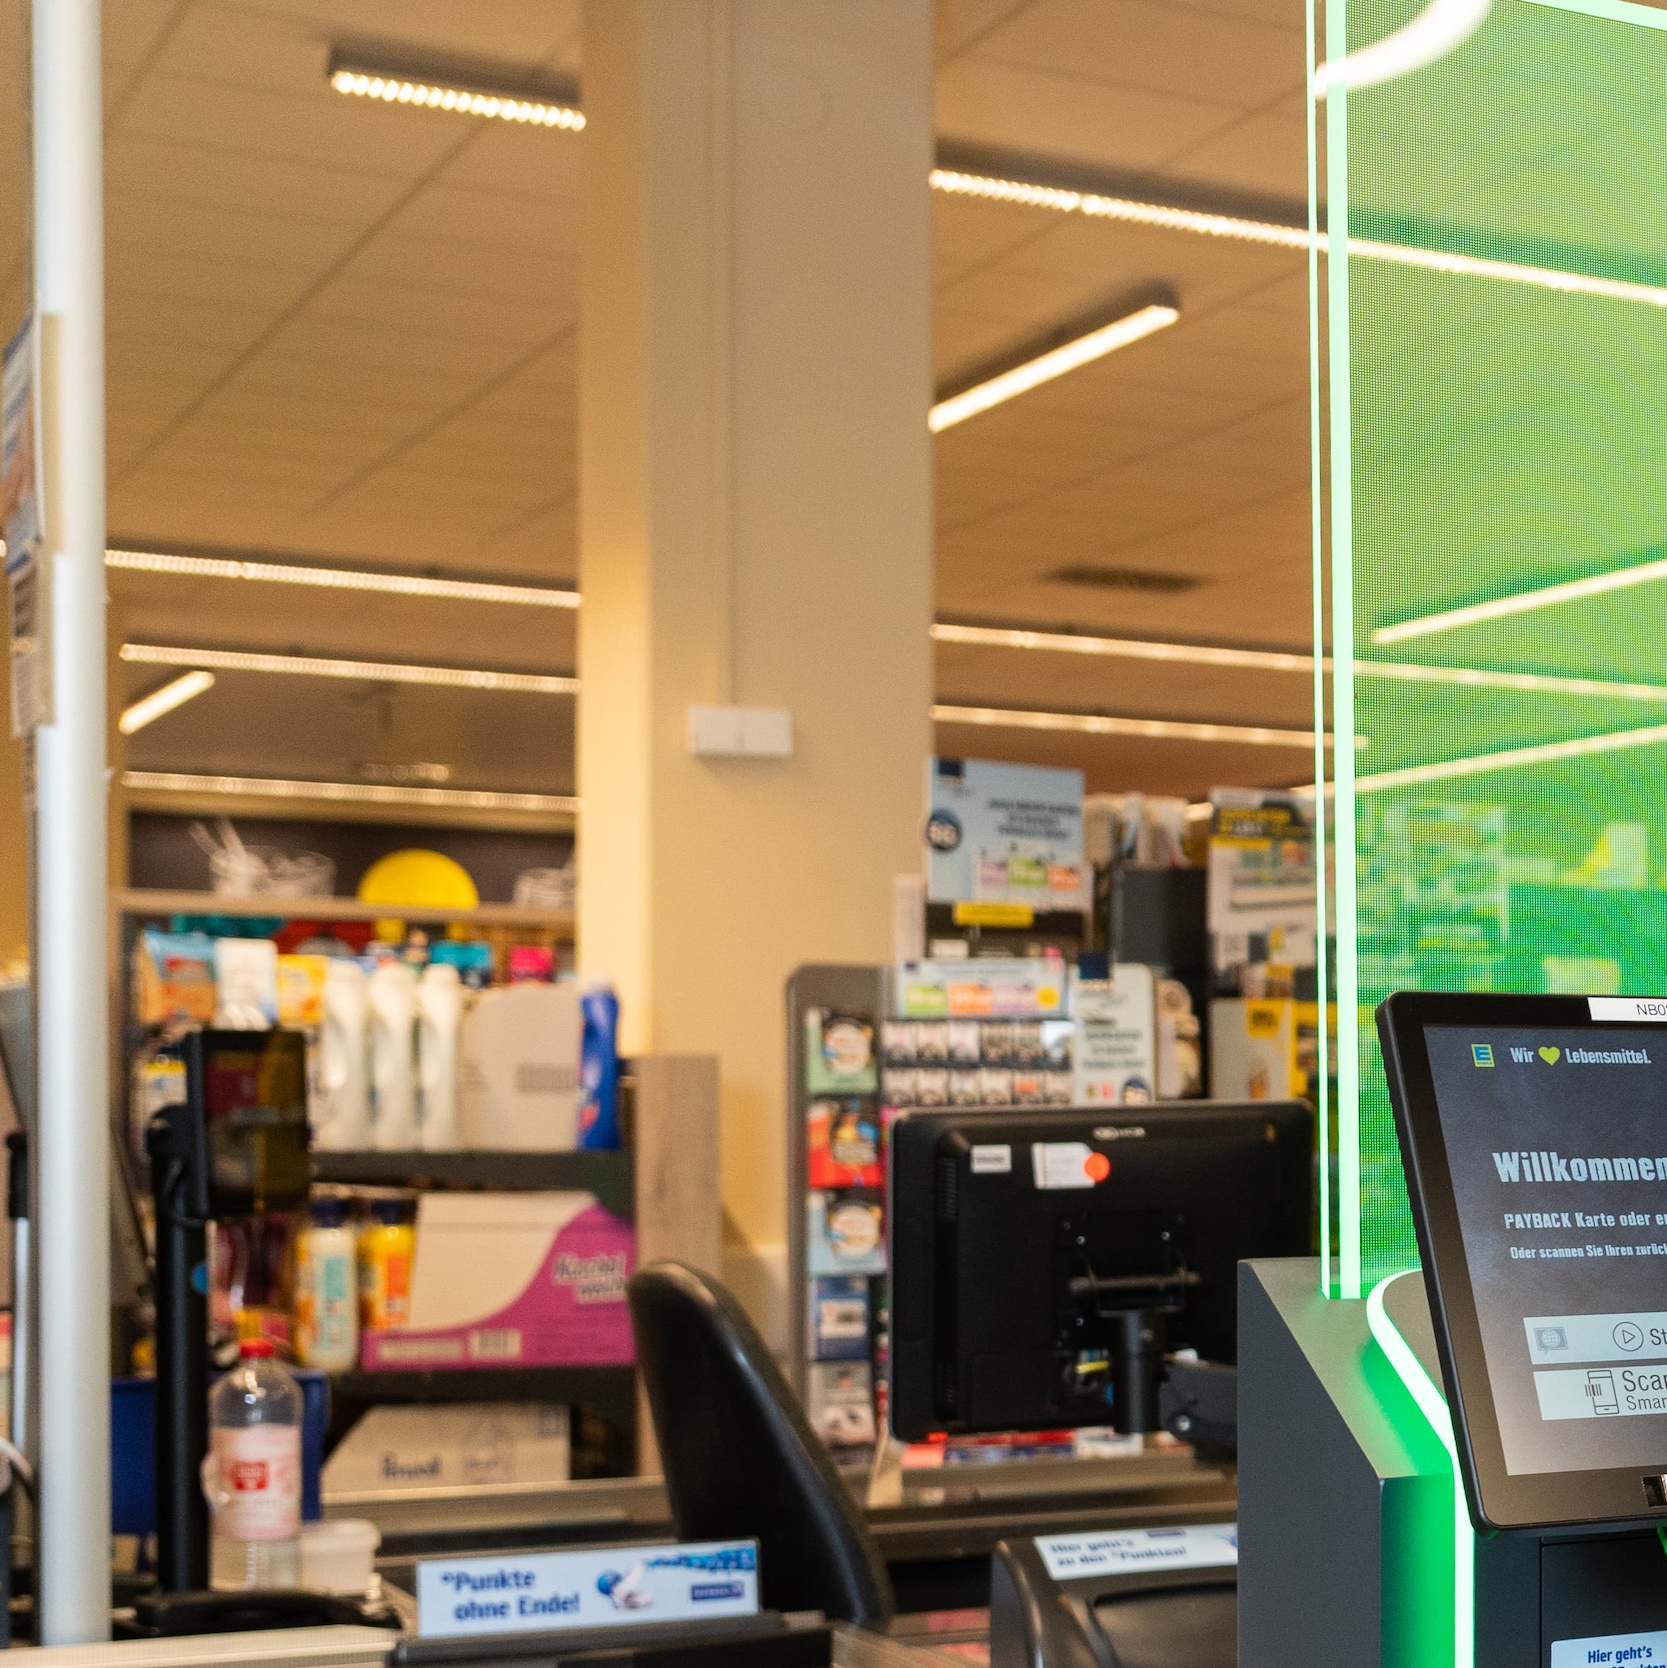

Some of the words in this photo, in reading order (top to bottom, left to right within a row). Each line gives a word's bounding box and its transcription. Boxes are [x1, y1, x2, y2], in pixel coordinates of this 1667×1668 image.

[1510, 1047, 1535, 1063] Wir
[1565, 1048, 1652, 1065] Lebensmittel.
[1504, 1212, 1572, 1229] PAYBACK
[1575, 1211, 1616, 1227] Karte
[1619, 1210, 1651, 1226] oder
[1510, 1246, 1536, 1260] Oder
[1539, 1246, 1584, 1258] scannen
[1586, 1244, 1603, 1258] Sie
[1605, 1244, 1633, 1257] Ihren
[453, 1601, 510, 1621] ohne
[518, 1594, 581, 1618] Ende!
[1588, 1649, 1613, 1663] Hier
